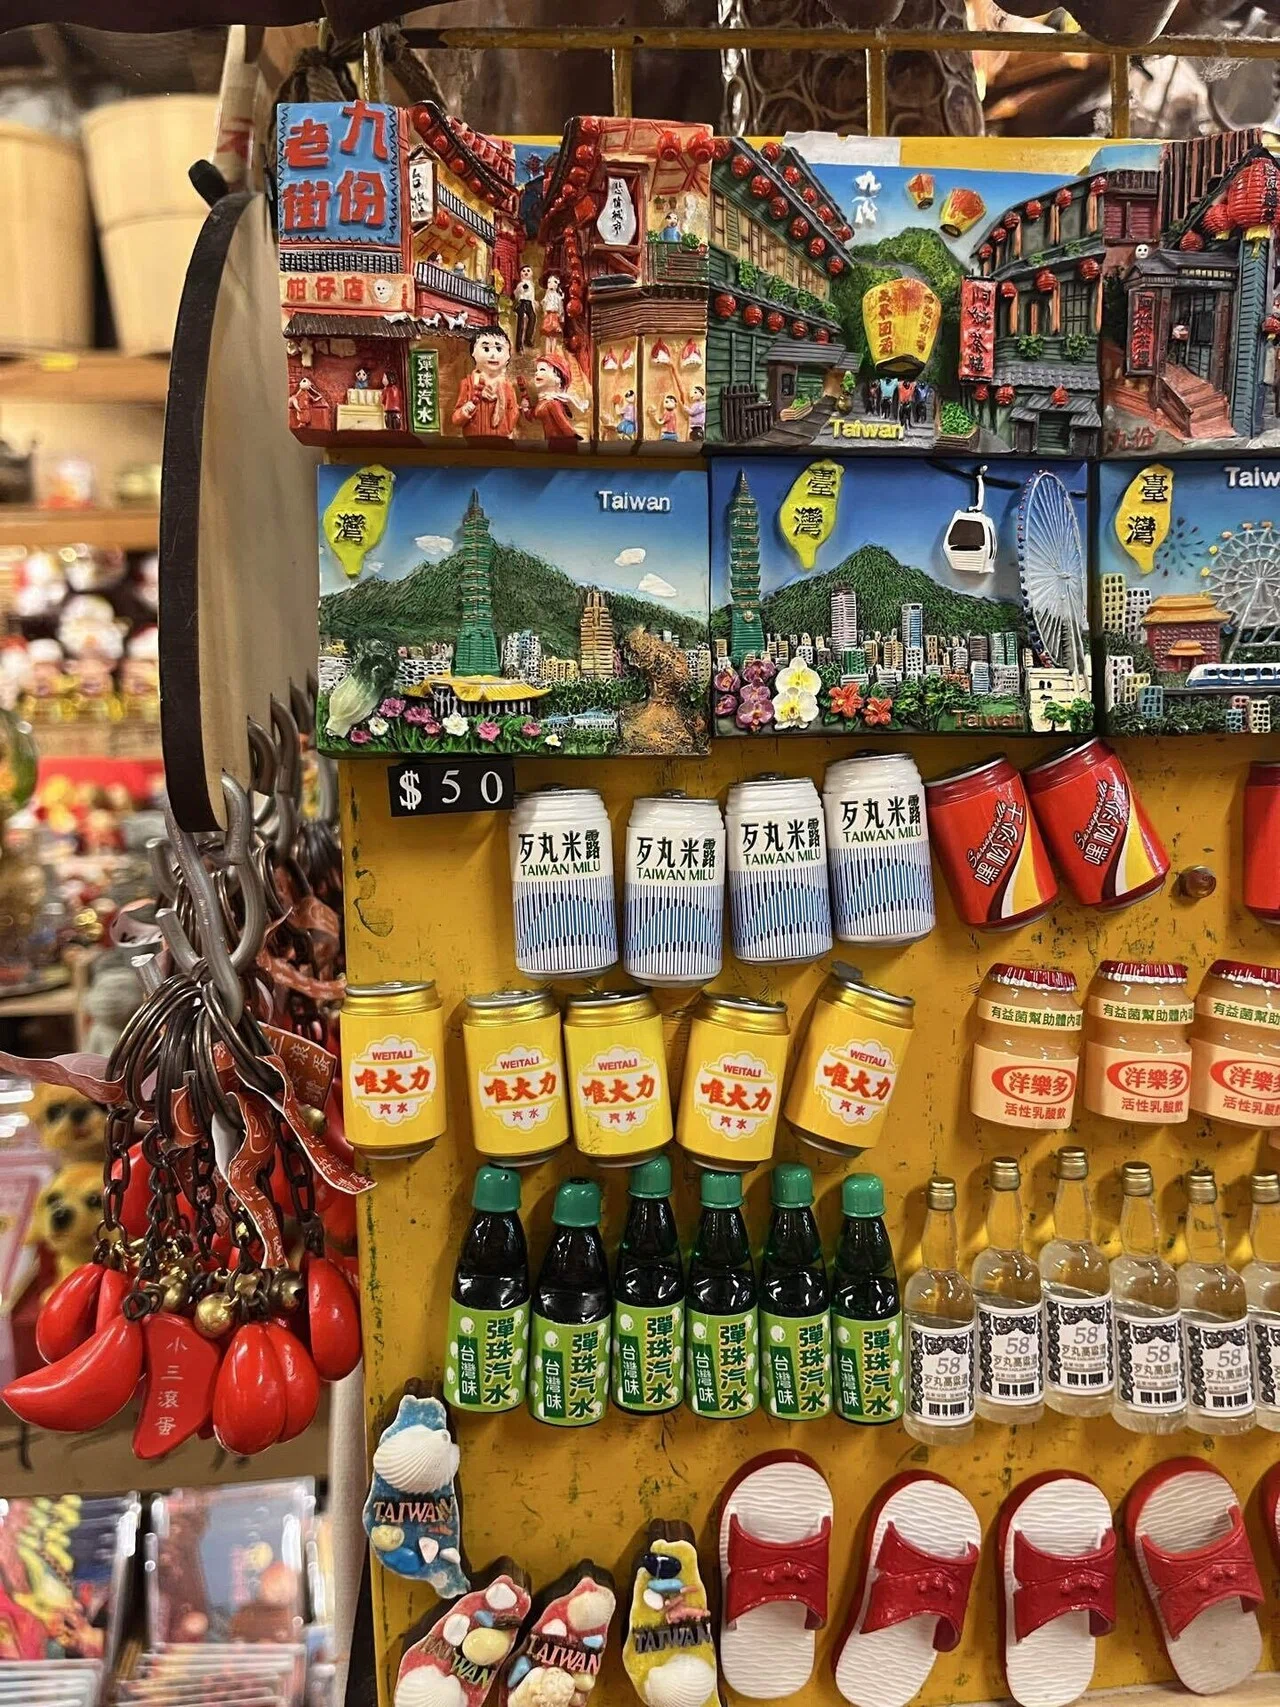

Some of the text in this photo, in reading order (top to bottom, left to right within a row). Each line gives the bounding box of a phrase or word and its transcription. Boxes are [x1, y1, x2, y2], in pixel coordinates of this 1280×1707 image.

[417, 355, 434, 422] 彈珠汽水
[829, 418, 904, 440] Taiwan
[599, 490, 671, 512] Taiwan
[793, 467, 840, 537] 臺灣
[1127, 473, 1171, 545] 臺灣
[843, 826, 922, 843] TAIWAN MILU
[520, 861, 601, 876] TAIWAN MILU
[743, 849, 821, 866] TAIWAN MILU
[636, 867, 716, 881] TAIWAN MILU
[372, 1050, 413, 1061] WEITALI
[500, 1057, 539, 1069] WEITALI
[597, 1057, 638, 1071] WEITALI
[850, 1049, 886, 1067] WEITALI
[355, 1066, 431, 1095] 唯大力
[723, 1064, 761, 1078] WEITALI
[823, 1062, 891, 1101] 唯大力
[1009, 1071, 1069, 1097] 洋樂多
[1125, 1067, 1184, 1090] 洋樂多
[483, 1072, 557, 1104] 唯大力
[582, 1074, 656, 1105] 唯大力
[701, 1078, 773, 1112] 唯大力
[380, 1102, 408, 1114] 汽水
[512, 1108, 540, 1121] 汽水
[609, 1110, 637, 1123] 汽水
[720, 1115, 747, 1130] 汽水
[840, 1100, 866, 1116] 汽水
[460, 1344, 478, 1395] 台灣味
[484, 1317, 515, 1405] 彈珠汽水
[568, 1331, 599, 1418] 彈珠汽水
[622, 1344, 639, 1395] 台灣味
[646, 1316, 673, 1404] 彈珠汽水
[720, 1323, 747, 1412] 彈珠汽水
[799, 1324, 826, 1412] 彈珠汽水
[864, 1330, 891, 1416] 彈珠汽水
[545, 1360, 562, 1409] 台灣味
[696, 1352, 715, 1404] 台灣味
[774, 1354, 794, 1406] 台灣味
[840, 1357, 859, 1408] 台灣味
[374, 1499, 455, 1523] TAIWAN
[635, 1625, 711, 1653] TAIWAN
[526, 1634, 600, 1675] TAIWAN
